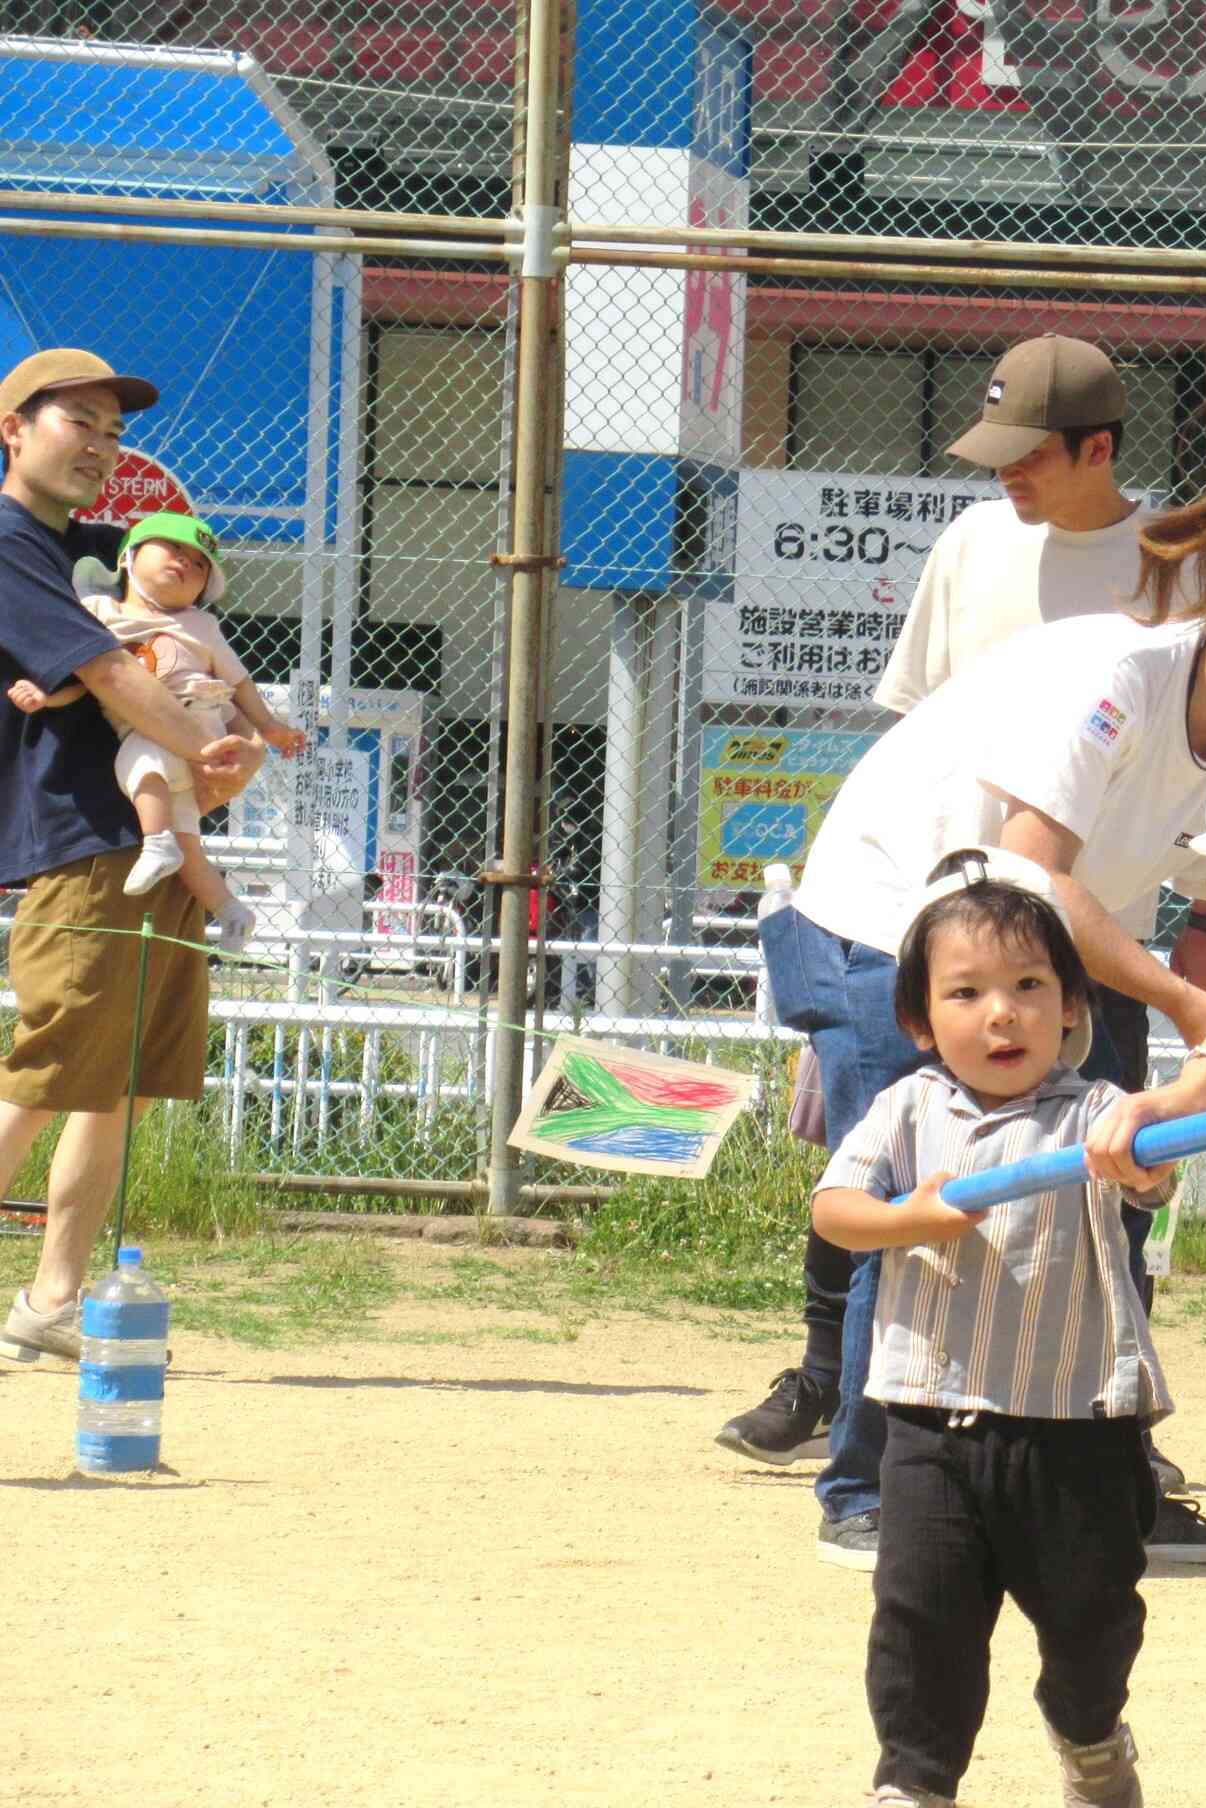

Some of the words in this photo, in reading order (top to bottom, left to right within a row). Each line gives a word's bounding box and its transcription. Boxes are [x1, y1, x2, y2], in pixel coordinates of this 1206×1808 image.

[820, 487, 997, 523] 駐車場利用
